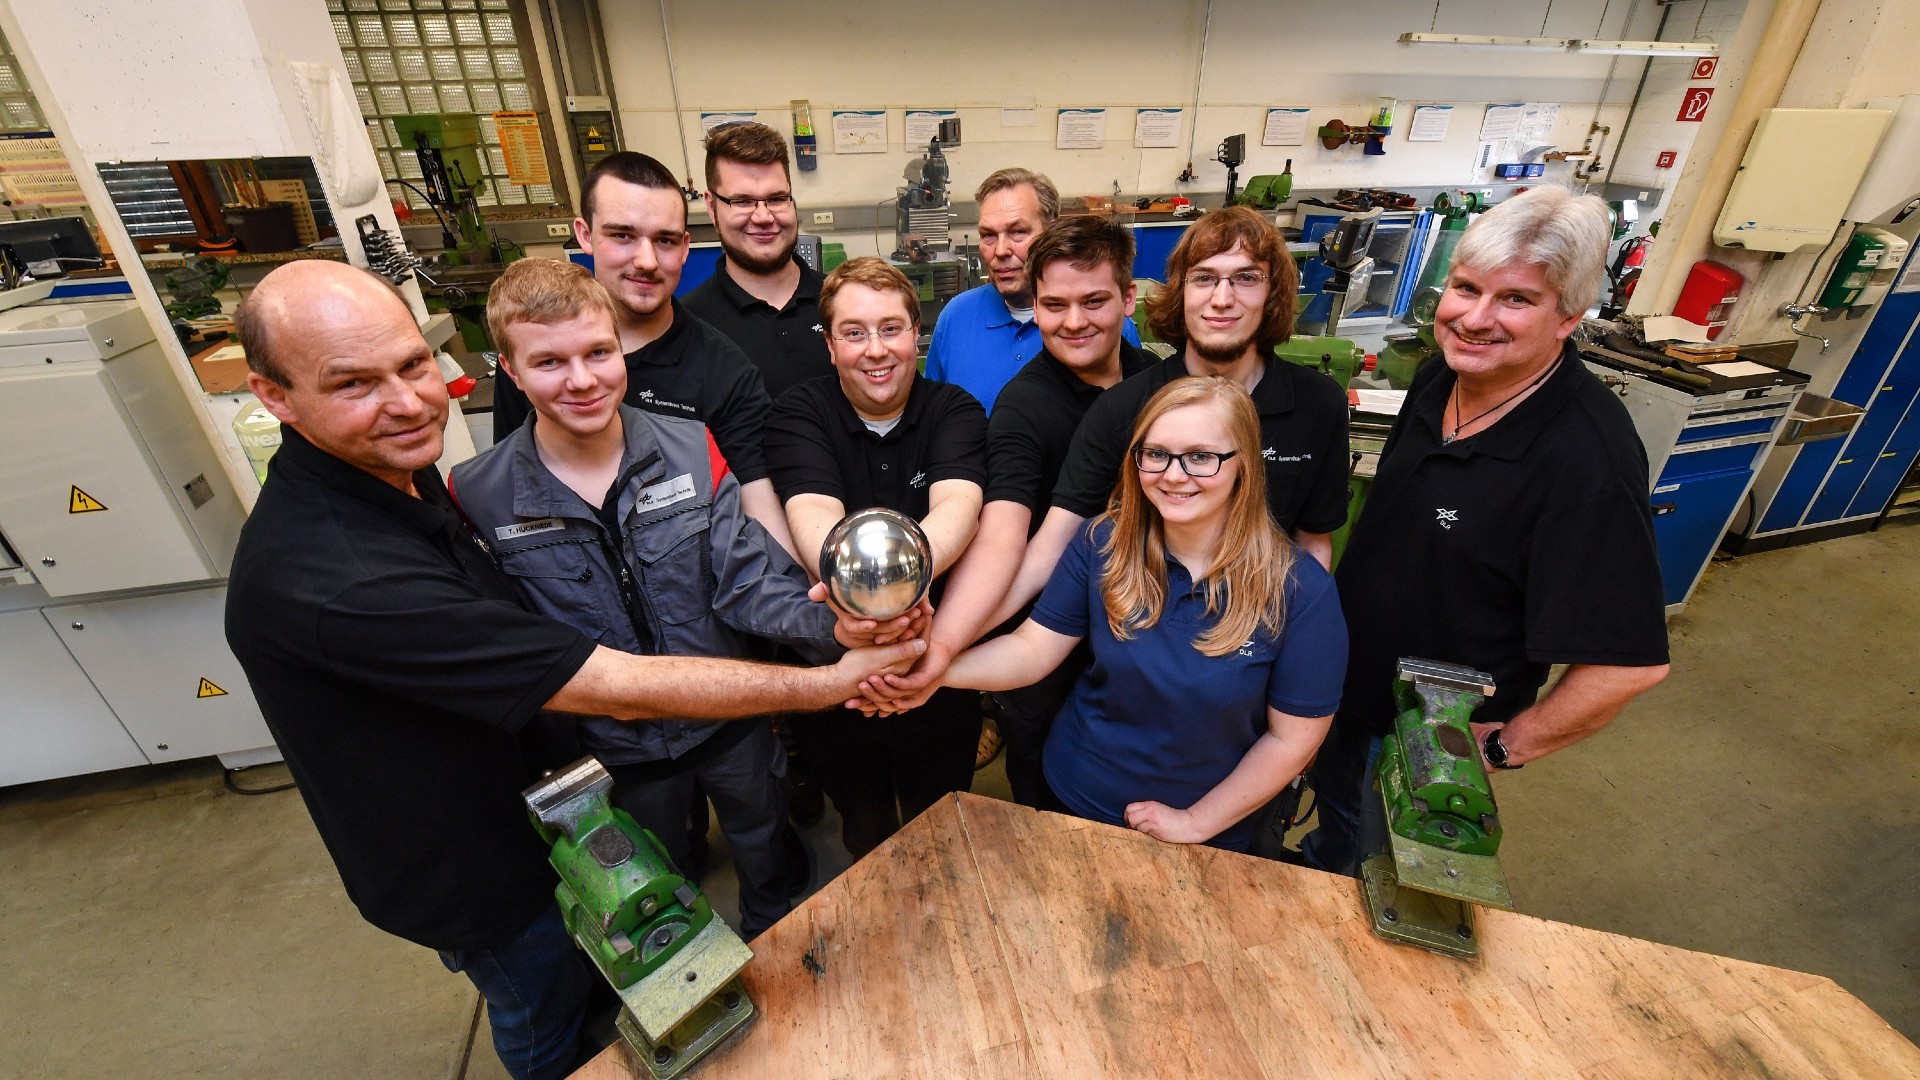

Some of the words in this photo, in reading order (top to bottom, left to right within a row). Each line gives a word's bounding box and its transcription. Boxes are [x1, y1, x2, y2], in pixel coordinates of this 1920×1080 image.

[1440, 519, 1451, 531] DLR
[508, 528, 516, 536] T.
[1239, 648, 1253, 658] DLR
